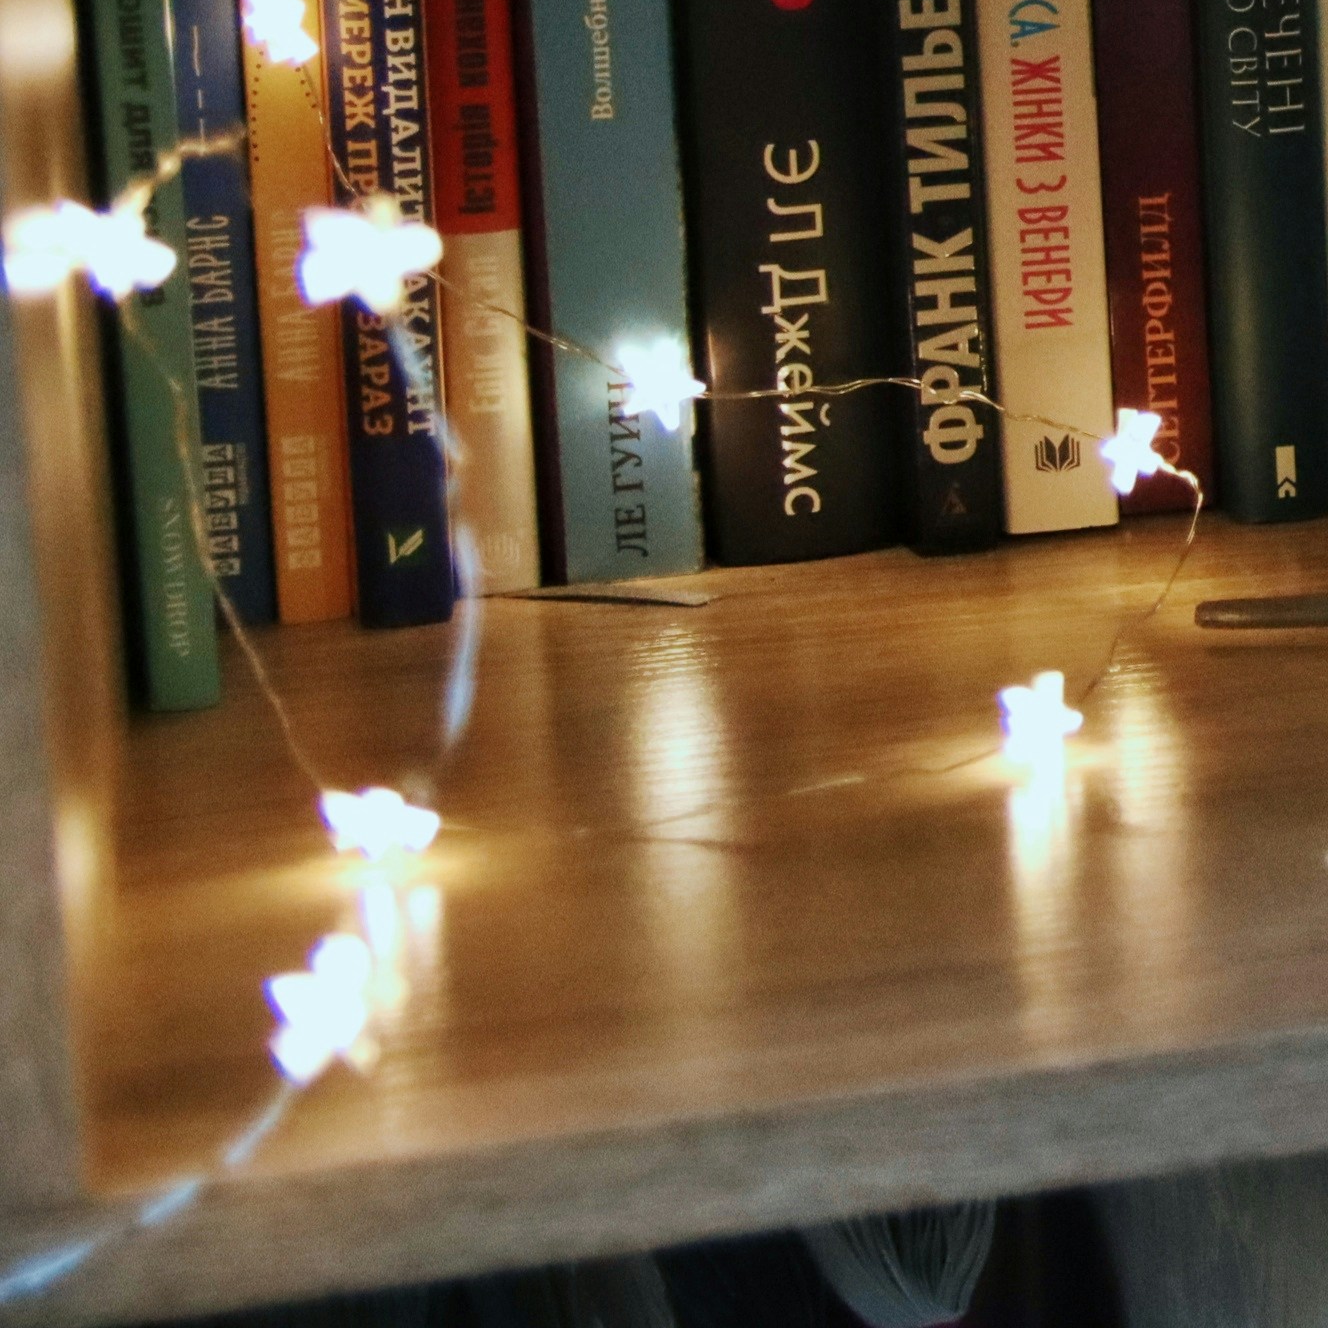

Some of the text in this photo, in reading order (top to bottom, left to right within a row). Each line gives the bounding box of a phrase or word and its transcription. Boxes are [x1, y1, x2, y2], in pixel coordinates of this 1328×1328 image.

[383, 28, 428, 228] ВИДАЛИТ
[1010, 56, 1064, 164] ЖІНКИ
[1227, 26, 1263, 138] СВІТУ
[1016, 175, 1067, 193] З
[186, 215, 238, 390] АННА БАРНС
[1017, 205, 1074, 330] ВЕНЕРИ
[911, 226, 984, 464] ФРАНК
[613, 504, 649, 557] ЛЕ
